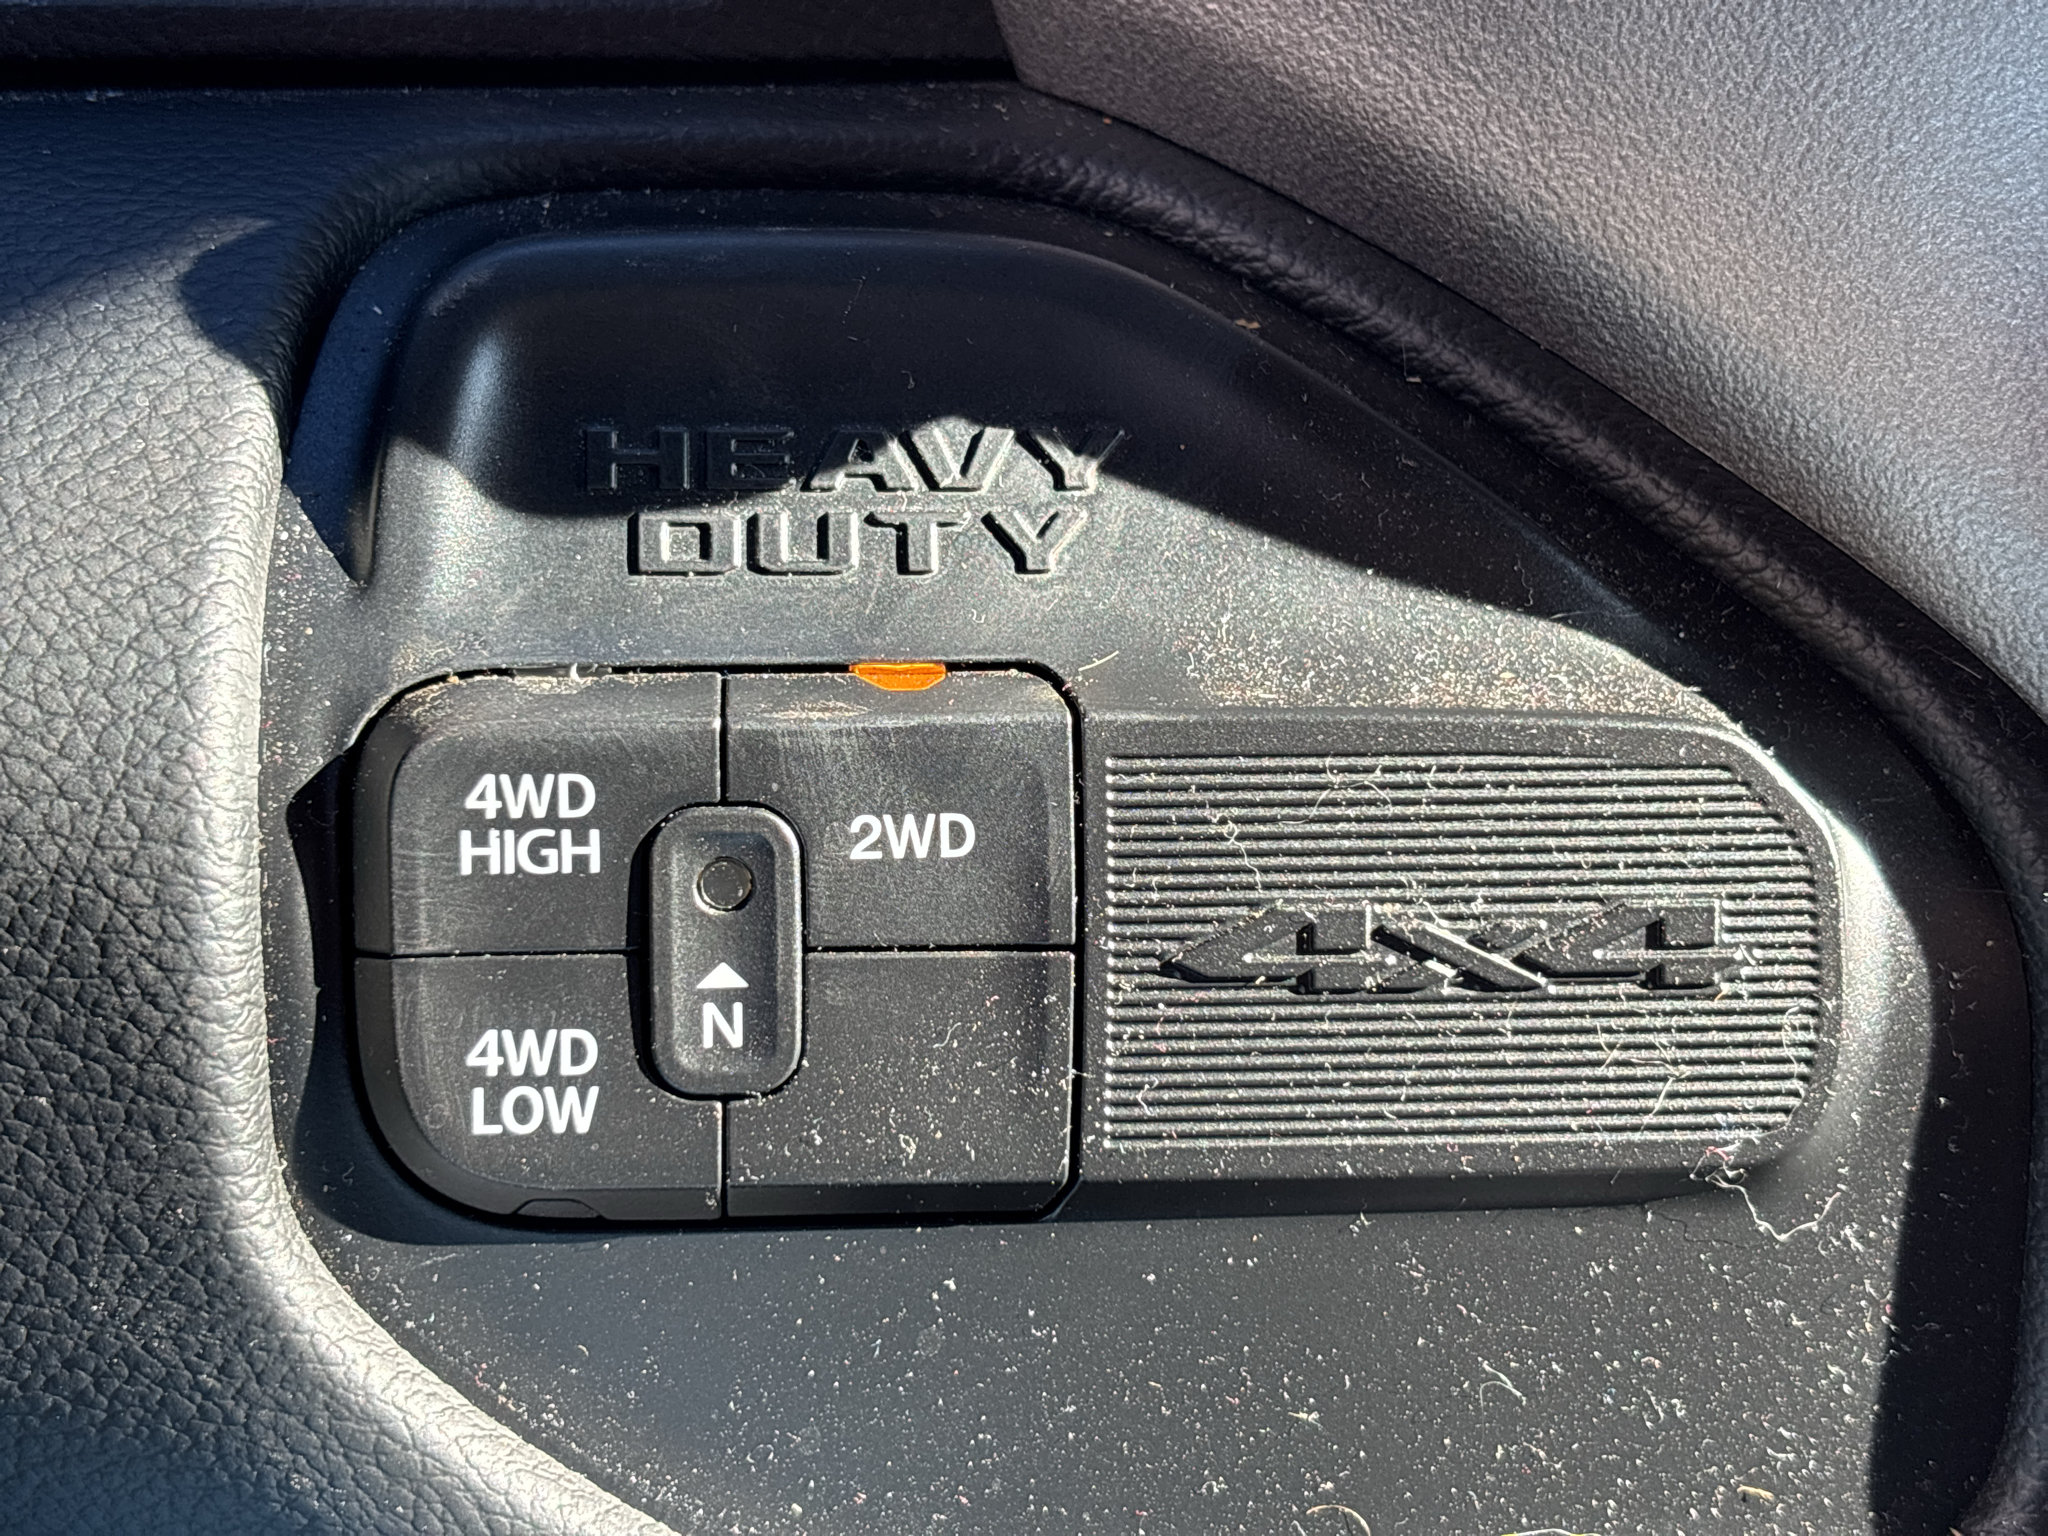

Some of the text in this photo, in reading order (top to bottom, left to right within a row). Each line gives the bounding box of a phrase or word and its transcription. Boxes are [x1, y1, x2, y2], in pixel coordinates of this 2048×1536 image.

[583, 425, 1124, 494] HEAVY
[627, 510, 1089, 576] DUTY
[465, 773, 597, 819] 4WD
[459, 828, 601, 876] HIGH
[848, 812, 977, 860] 2WD
[701, 1001, 745, 1049] N
[465, 1028, 599, 1077] 4WD
[470, 1085, 600, 1135] LOW
